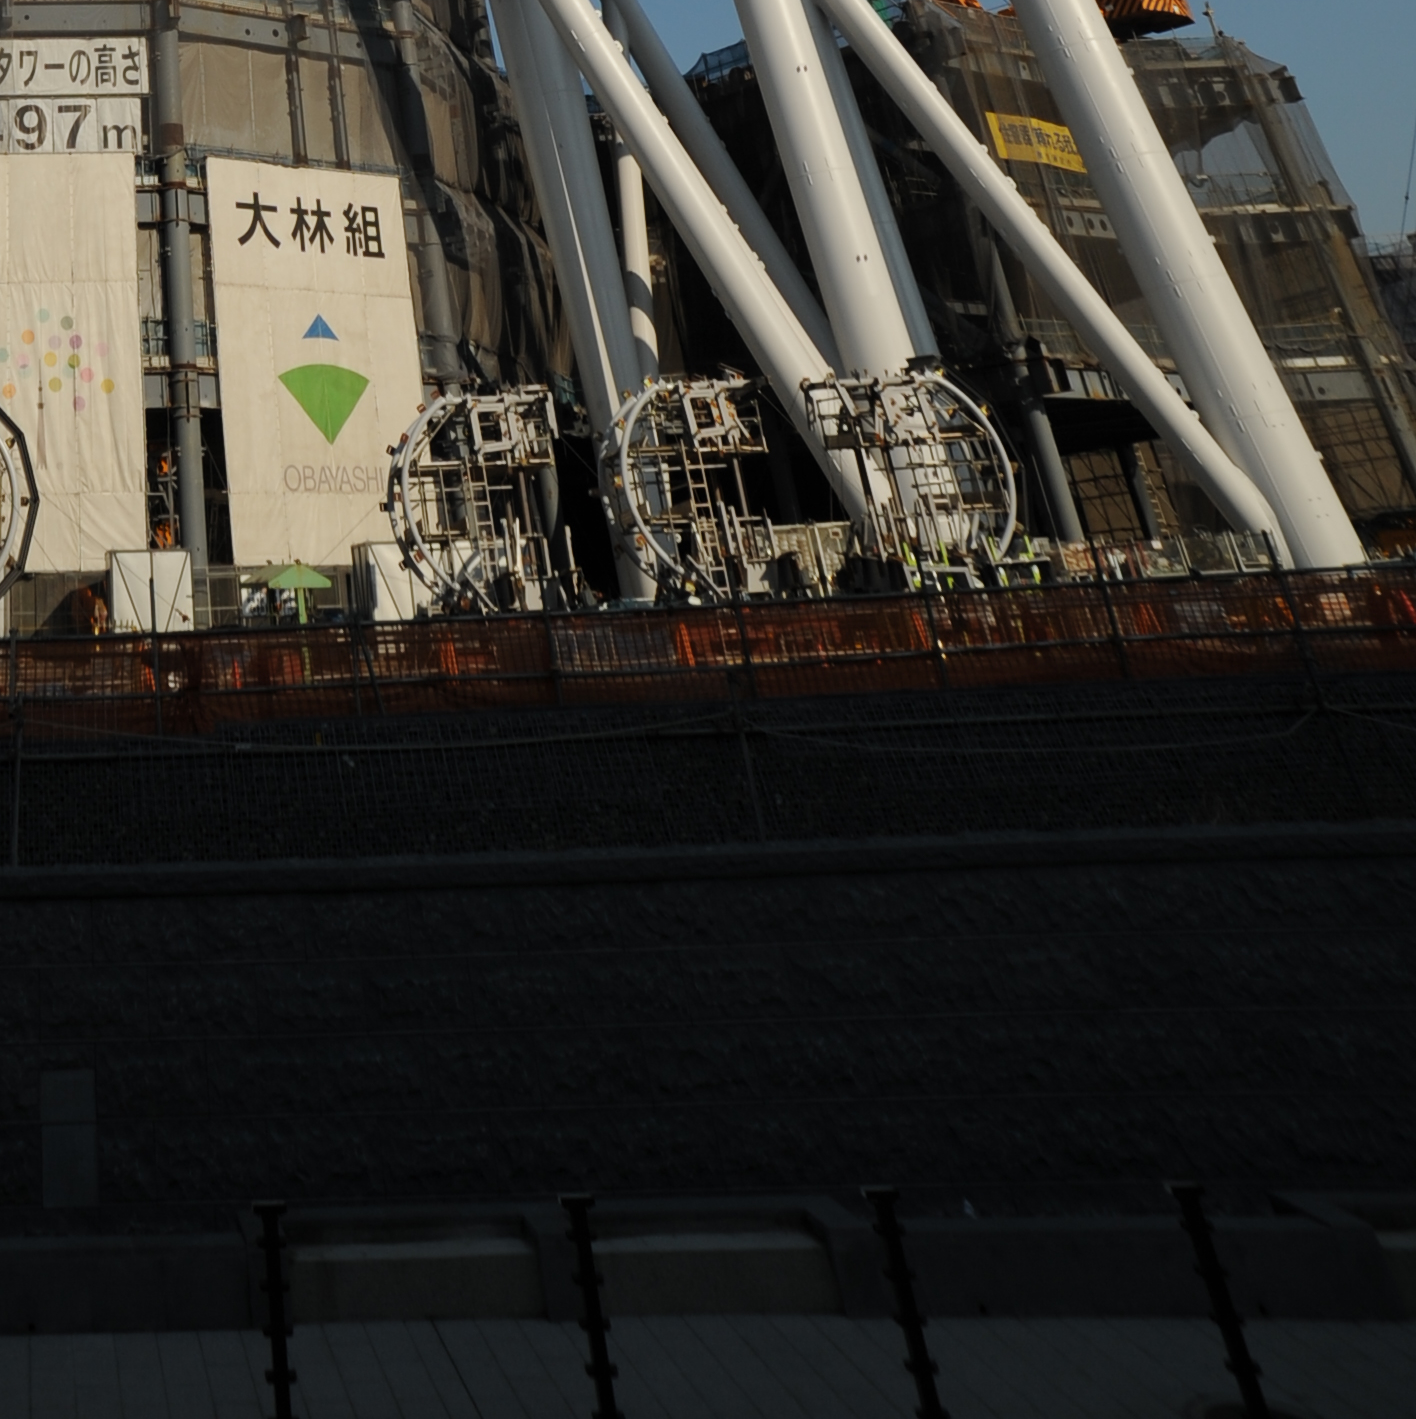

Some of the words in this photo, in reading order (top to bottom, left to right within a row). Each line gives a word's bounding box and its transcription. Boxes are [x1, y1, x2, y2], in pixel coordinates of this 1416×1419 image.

[235, 191, 386, 259] 大林組
[284, 464, 385, 493] OBAYASHI
